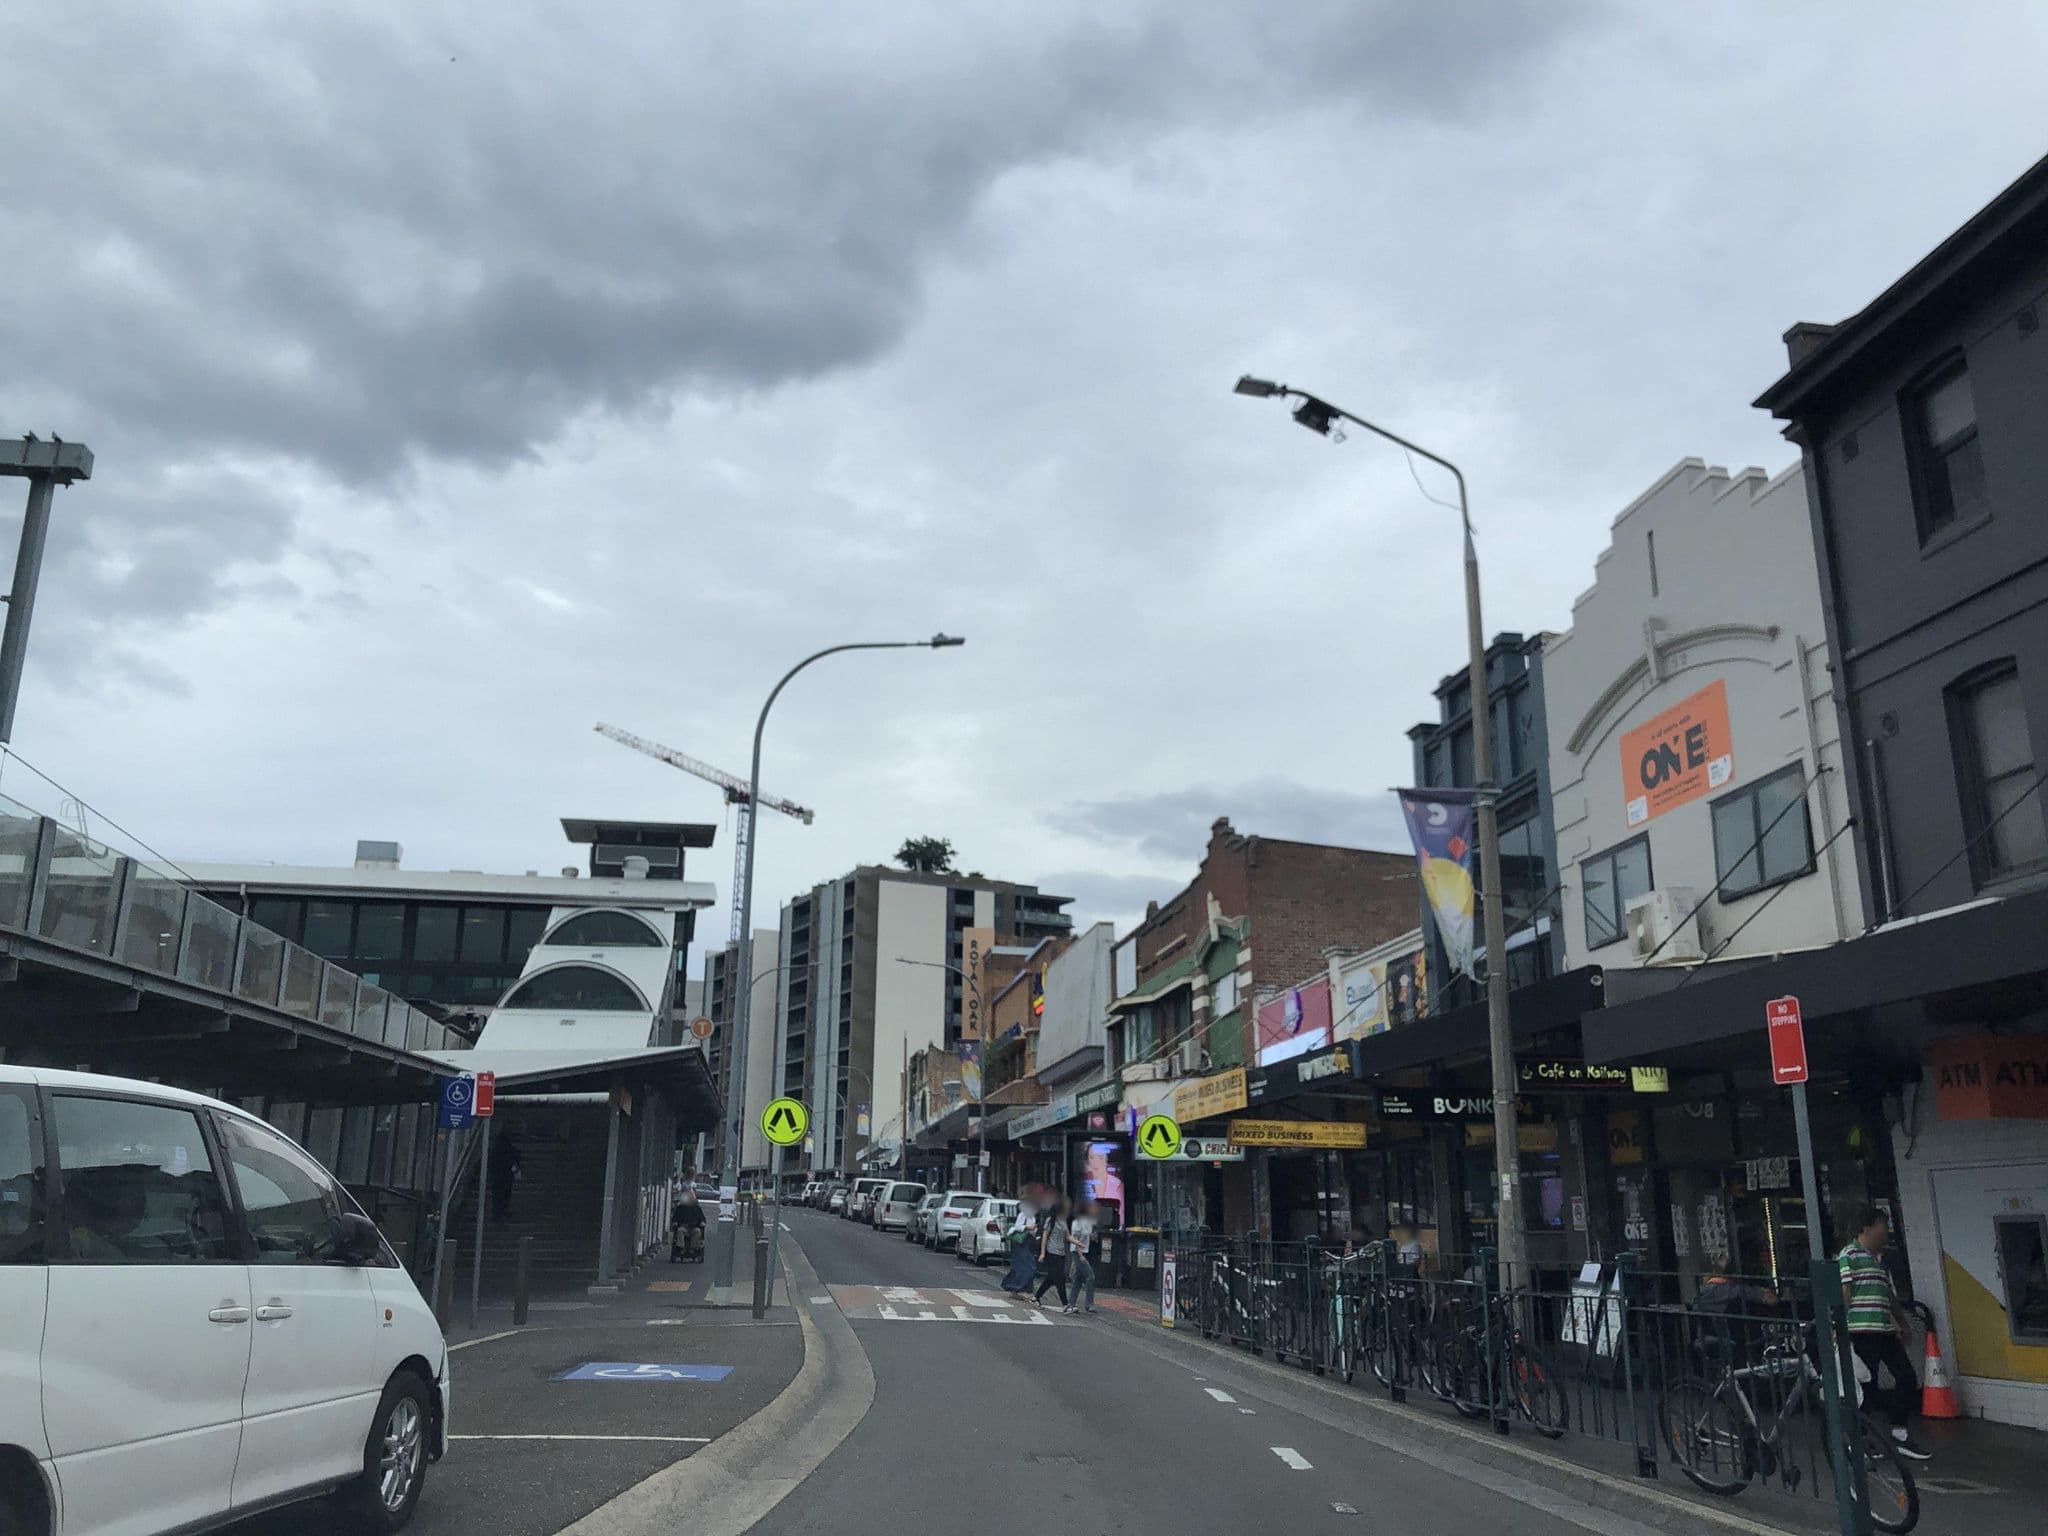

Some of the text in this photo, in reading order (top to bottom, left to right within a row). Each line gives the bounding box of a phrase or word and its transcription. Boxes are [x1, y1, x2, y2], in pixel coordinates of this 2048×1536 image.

[969, 999, 979, 1031] OAK
[1777, 1004, 1788, 1014] NO
[1771, 1014, 1798, 1027] STOPPING
[1538, 1063, 1564, 1080] Café
[1569, 1069, 1581, 1078] on
[1587, 1065, 1627, 1083] Railway
[1940, 1063, 1981, 1088] ATM
[1232, 1130, 1265, 1140] MIXED
[1267, 1131, 1314, 1141] BUSINESS
